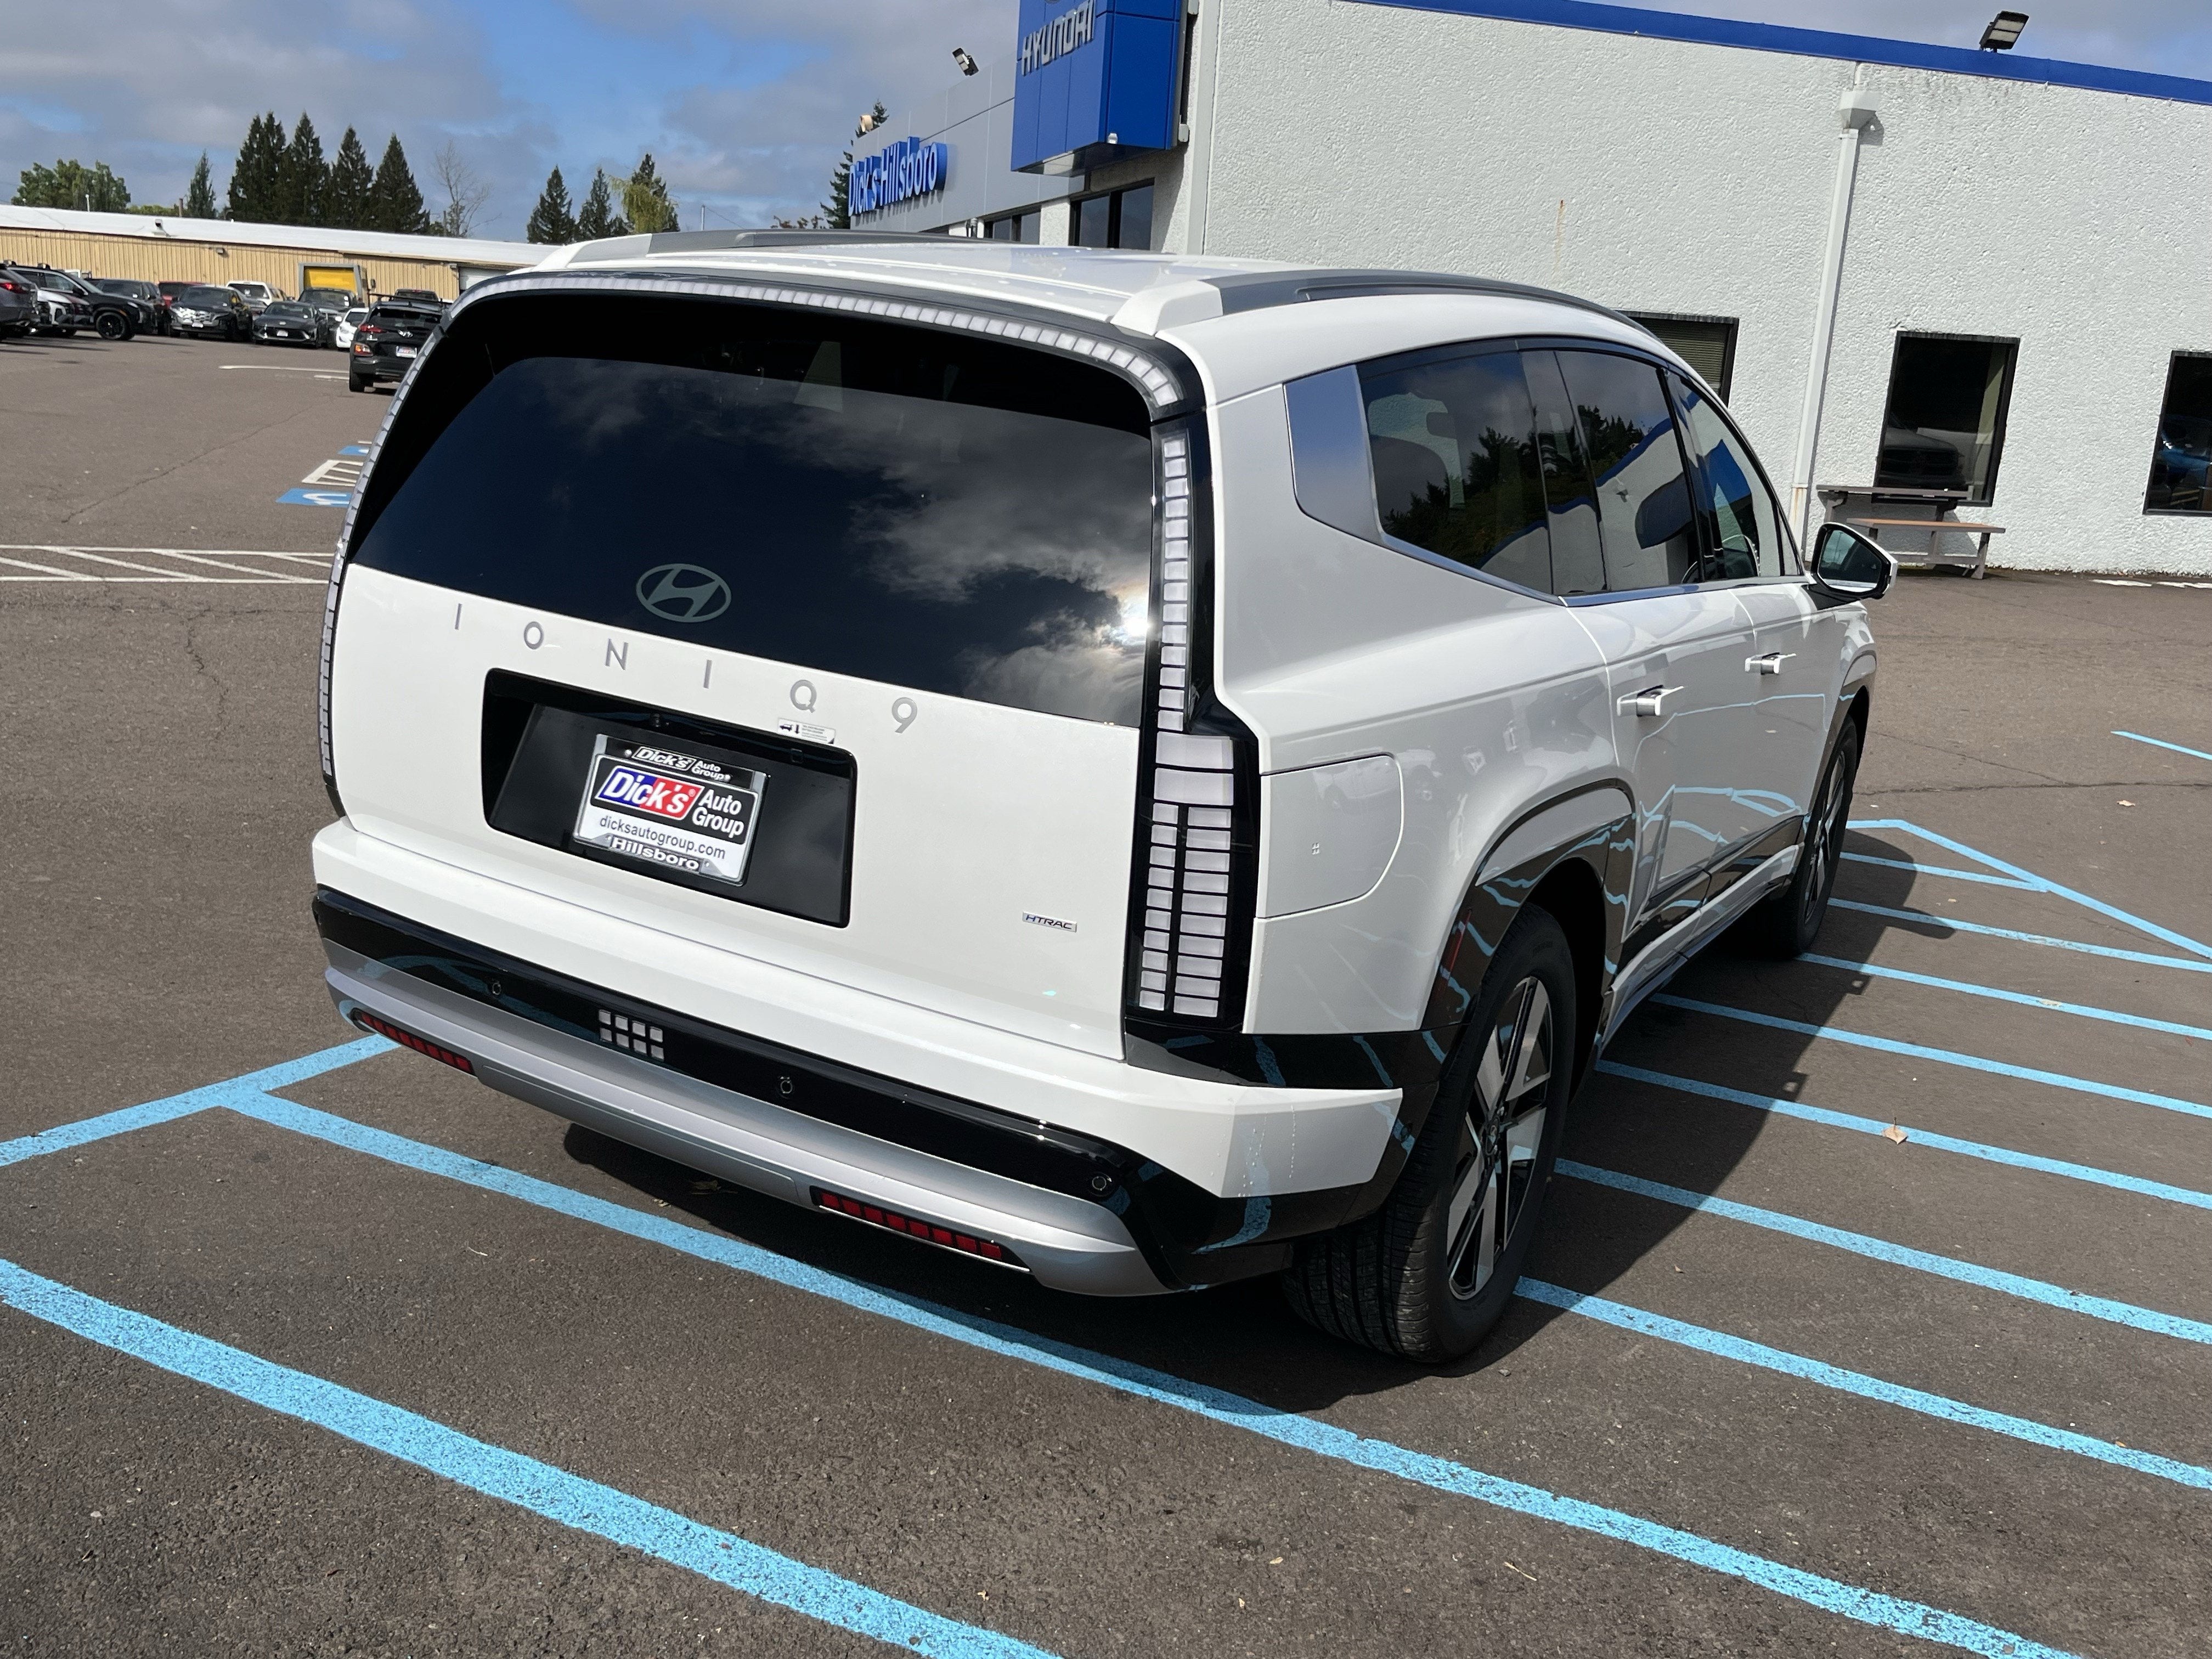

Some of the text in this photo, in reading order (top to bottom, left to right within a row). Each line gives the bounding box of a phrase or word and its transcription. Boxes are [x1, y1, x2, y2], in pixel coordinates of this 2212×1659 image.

[1022, 0, 1094, 76] HYUNDAI
[848, 137, 939, 217] Dick's Hillsboro
[454, 603, 918, 734] IONIQ 9
[691, 767, 725, 781] Group
[694, 760, 721, 772] Auto
[698, 789, 742, 816] Auto
[600, 815, 726, 860] dicksautogroup.com
[691, 806, 745, 839] Group
[611, 837, 699, 871] Hillsboro
[1025, 914, 1073, 930] HTRAC
